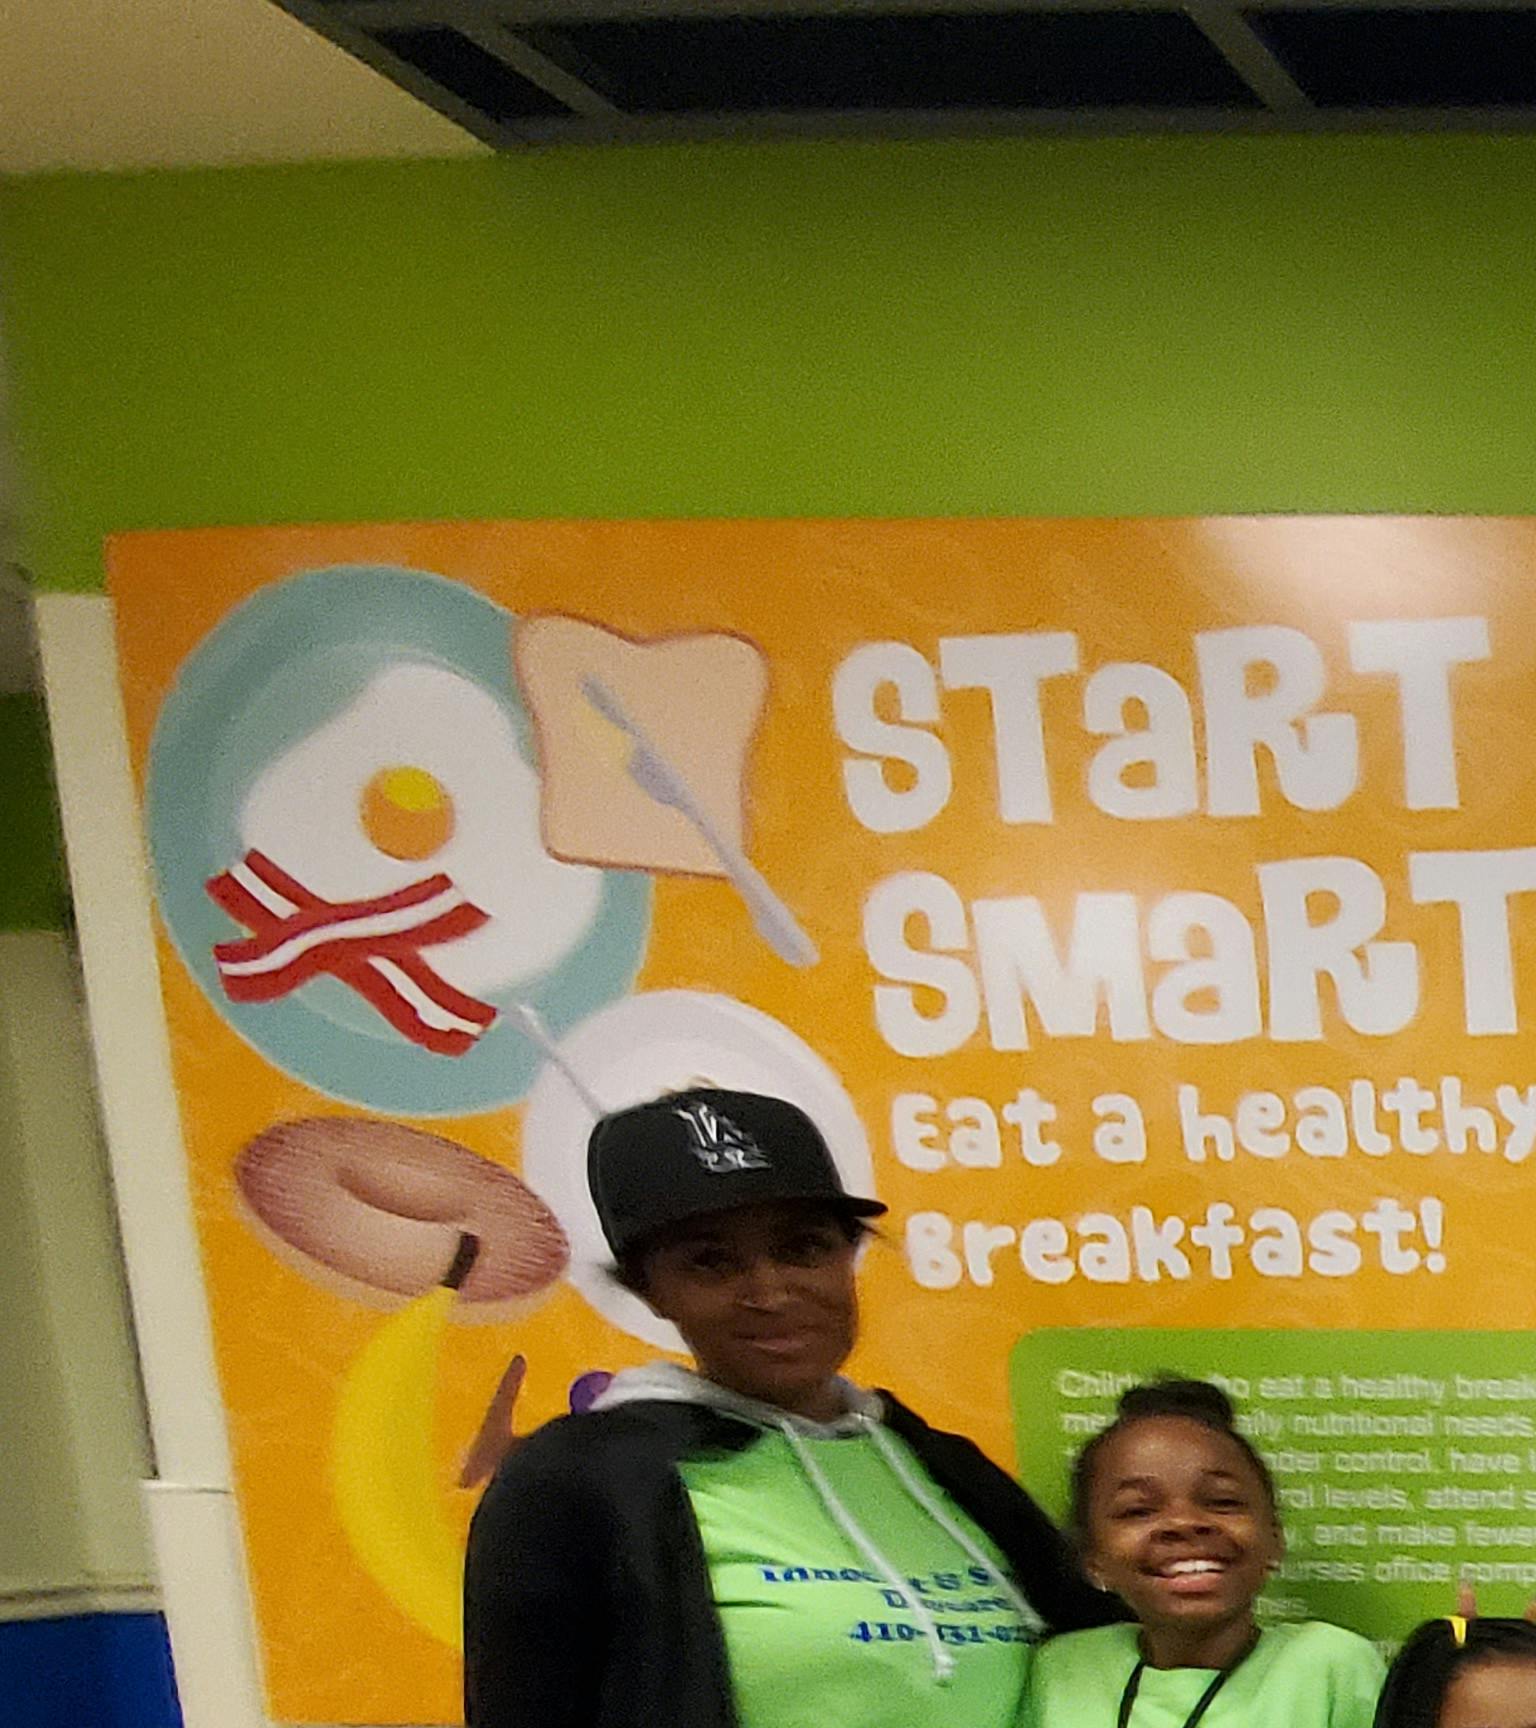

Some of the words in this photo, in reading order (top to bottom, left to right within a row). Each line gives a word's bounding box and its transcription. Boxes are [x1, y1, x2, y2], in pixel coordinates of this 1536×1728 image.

[892, 1088, 1060, 1171] Eat
[1093, 1094, 1146, 1164] a
[904, 1198, 1449, 1290] Breakfast!
[1341, 1374, 1446, 1404] healthy
[1293, 1411, 1434, 1437] nutritional
[1450, 1449, 1521, 1474] have
[1424, 1485, 1517, 1510] attend
[1313, 1522, 1368, 1547] and
[1376, 1521, 1456, 1547] make
[1374, 1555, 1450, 1583] office
